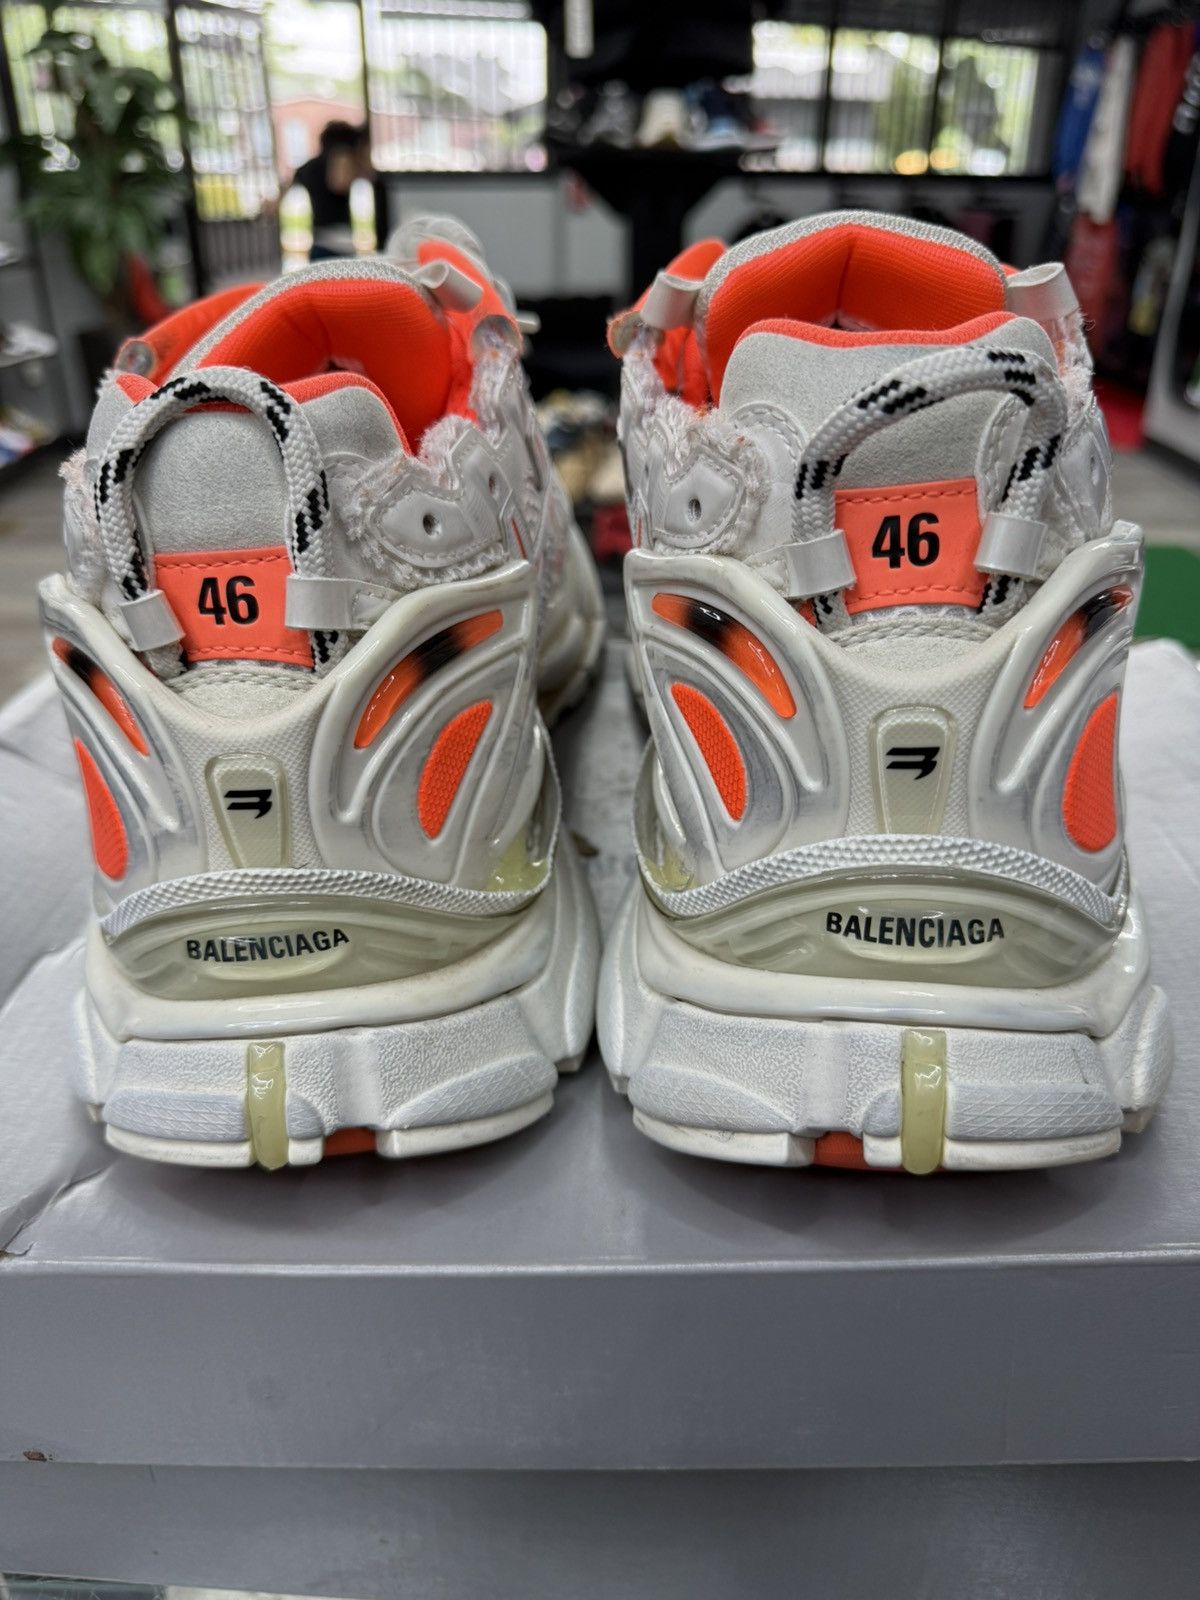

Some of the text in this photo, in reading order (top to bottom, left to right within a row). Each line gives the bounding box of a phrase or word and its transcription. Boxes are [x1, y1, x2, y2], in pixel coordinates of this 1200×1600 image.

[871, 511, 940, 569] 46
[197, 575, 259, 626] 46
[186, 928, 350, 963] BALENCIAGA
[825, 911, 1005, 949] BALENCIAGA
